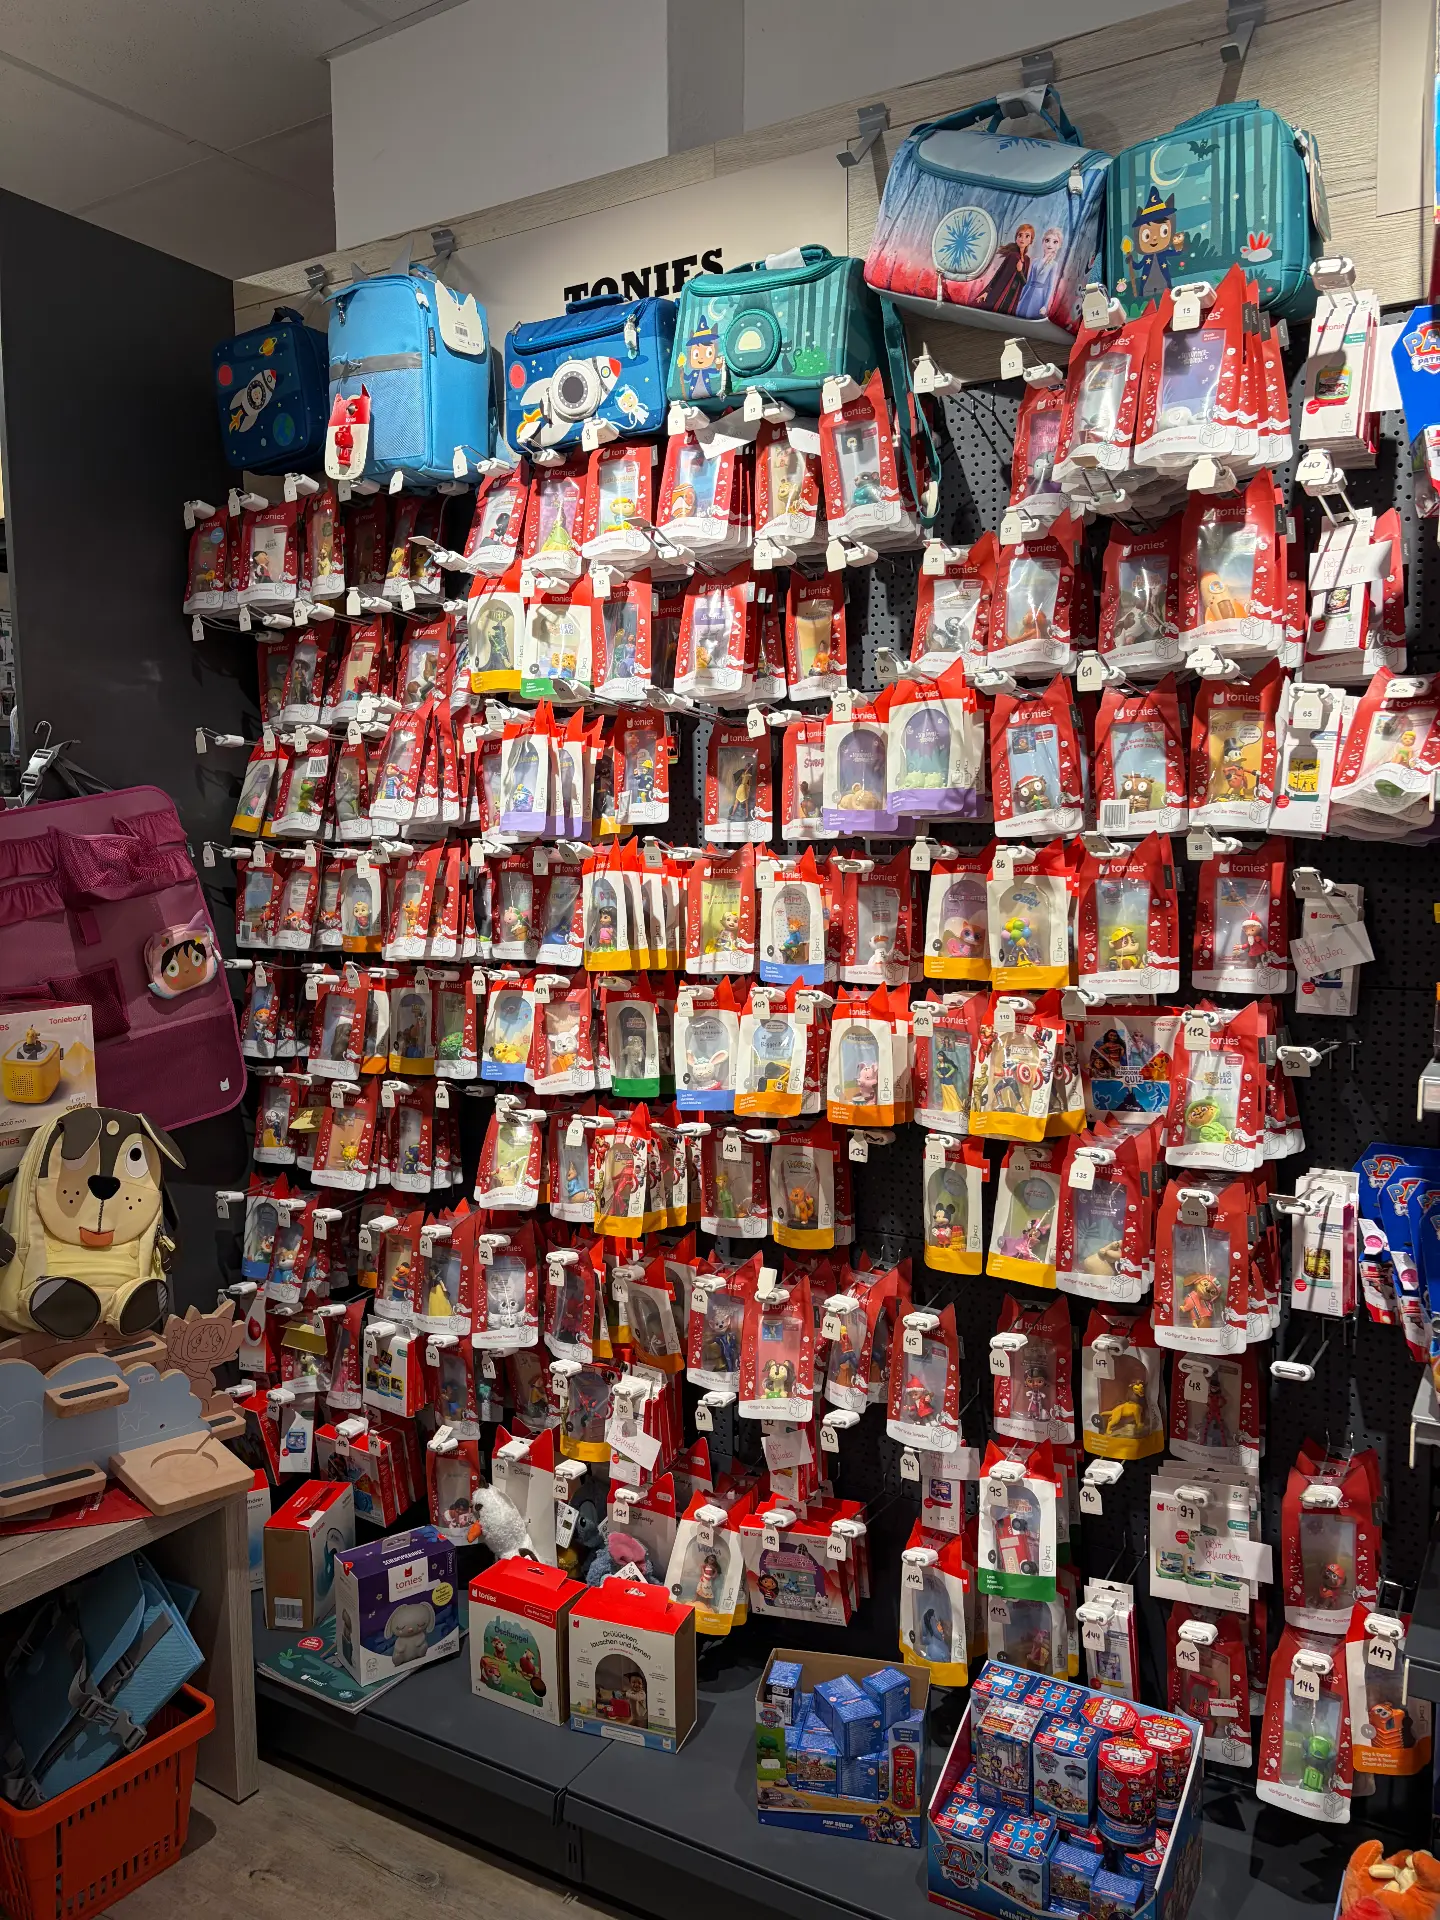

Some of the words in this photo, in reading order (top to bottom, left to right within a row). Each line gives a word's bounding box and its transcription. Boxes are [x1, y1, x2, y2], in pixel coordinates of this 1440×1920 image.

[564, 248, 724, 305] TONIES
[1182, 307, 1191, 315] 15
[844, 406, 872, 417] tonies
[1219, 507, 1252, 517] tonies
[1026, 544, 1057, 553] tonies
[948, 565, 978, 574] tonies
[708, 583, 732, 591] tonies
[808, 587, 831, 596] tonies
[613, 589, 635, 598] tonies
[552, 595, 572, 603] tonies
[660, 606, 681, 614] tonies
[1082, 667, 1092, 677] 61
[915, 690, 939, 699] tonies
[1227, 693, 1260, 703] tonies
[836, 703, 846, 712] 59
[1396, 699, 1435, 708] tonies
[852, 711, 876, 720] tonies
[1021, 708, 1052, 718] tonies
[1126, 707, 1159, 717] tonies
[748, 720, 758, 728] 58
[730, 734, 754, 742] tonies
[509, 861, 529, 869] tonies
[996, 860, 1005, 868] 86
[1111, 864, 1143, 873] tonies
[1232, 864, 1265, 873] tonies
[870, 873, 896, 882] tonies
[555, 990, 576, 998] tonies
[797, 1003, 810, 1011] 108
[48, 1016, 81, 1026] Toniebox
[82, 1013, 87, 1021] 2
[914, 1017, 929, 1026] 109
[942, 1016, 968, 1025] tonies
[1187, 1027, 1207, 1037] 112
[1286, 1060, 1300, 1069] 90
[1125, 1075, 1143, 1083] QUIZ
[725, 1144, 737, 1153] 131
[851, 1148, 865, 1157] 132
[480, 1251, 488, 1259] 22
[551, 1270, 559, 1278] 24
[694, 1294, 704, 1302] 42
[1025, 1323, 1053, 1332] tonies
[906, 1338, 919, 1346] 45
[427, 1352, 436, 1360] 70
[1095, 1359, 1107, 1367] 47
[554, 1379, 564, 1388] 72
[1189, 1381, 1200, 1391] 48
[619, 1404, 628, 1413] 90
[696, 1412, 706, 1420] 91
[821, 1433, 835, 1443] 93
[903, 1459, 914, 1468] 94
[512, 1466, 534, 1478] Disney
[553, 1485, 567, 1493] 120
[989, 1486, 1002, 1496] 95
[1082, 1491, 1095, 1502] 96
[614, 1508, 627, 1517] 121
[1180, 1505, 1194, 1518] 97
[631, 1511, 654, 1525] Disney
[828, 1544, 841, 1553] 140
[395, 1574, 422, 1590] tonies
[907, 1574, 922, 1583] 142
[478, 1591, 495, 1602] tonies
[991, 1606, 1007, 1617] 143
[494, 1625, 529, 1644] Dschungel
[1086, 1630, 1100, 1641] 144
[590, 1639, 617, 1648] lauschen
[619, 1640, 631, 1649] und
[631, 1644, 651, 1659] lernen
[1370, 1646, 1392, 1661] 147
[1179, 1651, 1196, 1661] 145
[1297, 1680, 1315, 1693] 146
[946, 1868, 976, 1885] PATROL
